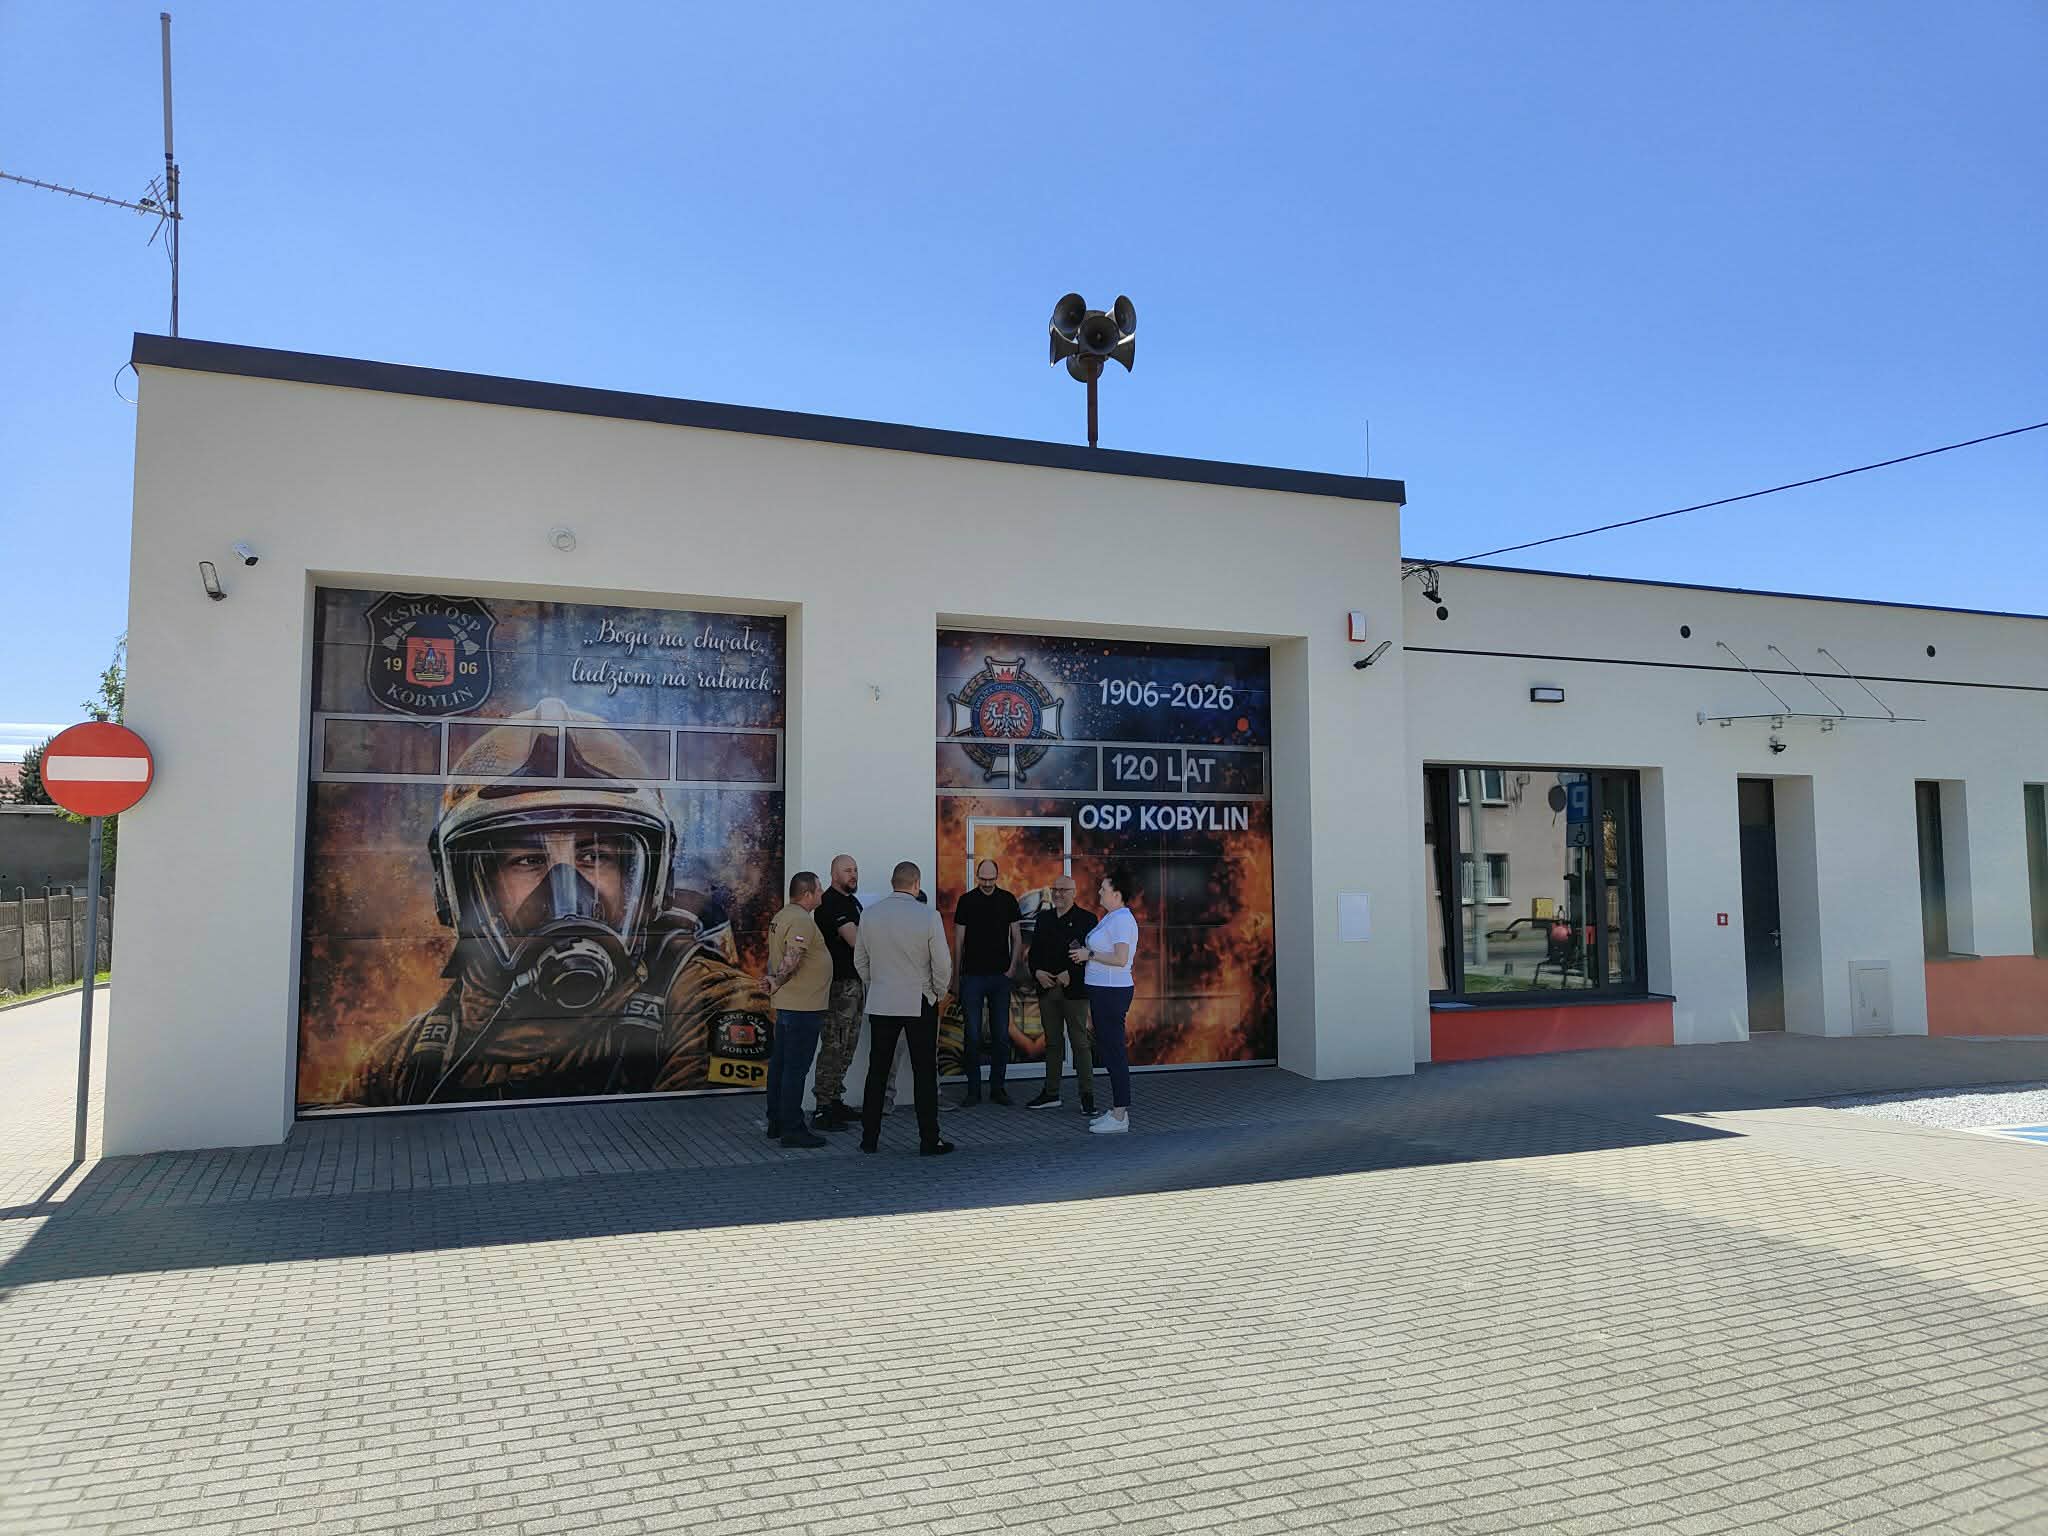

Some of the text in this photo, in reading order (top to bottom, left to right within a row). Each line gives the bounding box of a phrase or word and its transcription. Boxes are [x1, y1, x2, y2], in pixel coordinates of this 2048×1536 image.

[382, 602, 481, 632] KSRG OSP
[658, 633, 685, 648] na
[383, 657, 403, 671] 19
[459, 661, 478, 675] 06
[571, 657, 653, 696] ludziom
[662, 672, 689, 687] na
[386, 682, 475, 708] KOBYLIN
[1100, 678, 1234, 711] 1906-2026
[1111, 753, 1216, 783] 120 LAT
[1078, 804, 1249, 831] OSP KOBYLIN
[720, 1062, 764, 1082] OSP
